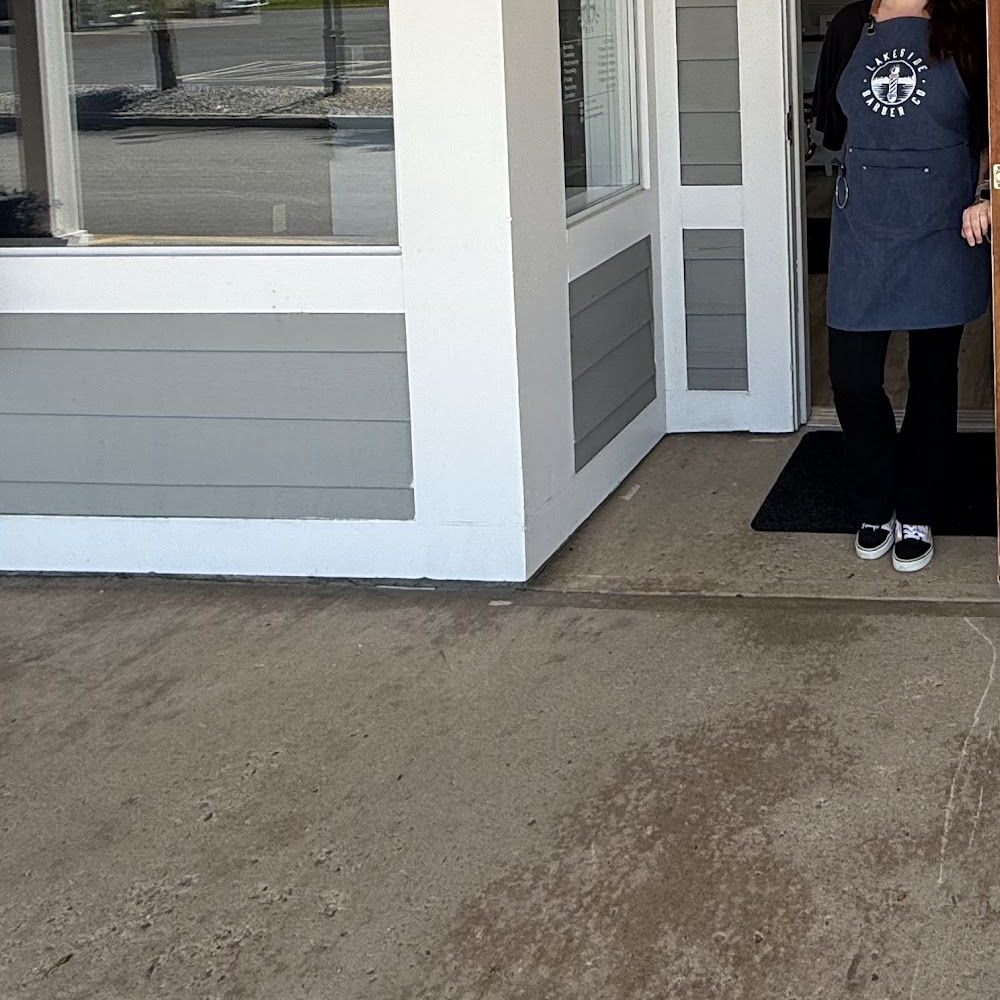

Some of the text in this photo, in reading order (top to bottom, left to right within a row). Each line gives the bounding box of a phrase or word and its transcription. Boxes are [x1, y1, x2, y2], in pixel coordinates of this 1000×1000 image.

[866, 48, 928, 73] LAKESIDE
[862, 89, 926, 117] BARBER CO
